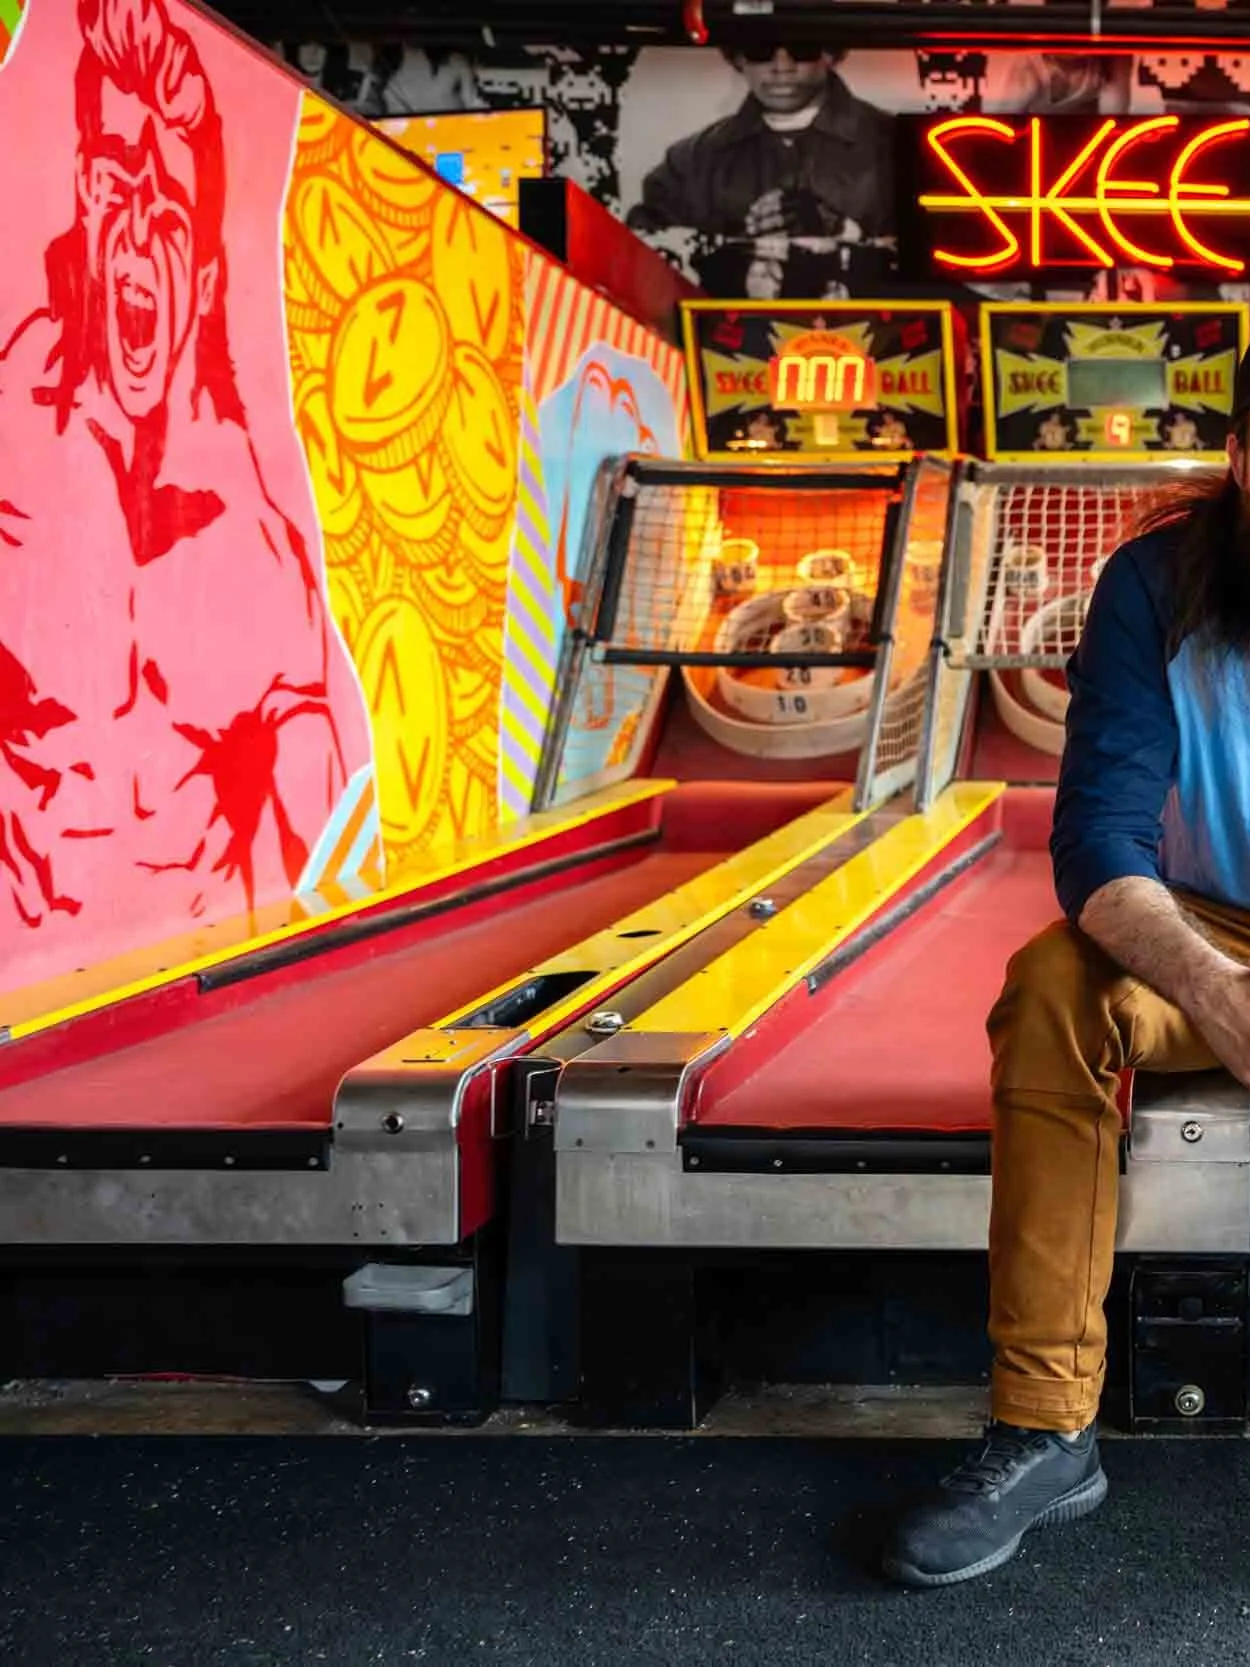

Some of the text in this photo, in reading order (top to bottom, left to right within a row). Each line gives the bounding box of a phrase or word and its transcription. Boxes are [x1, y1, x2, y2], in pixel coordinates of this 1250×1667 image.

[880, 370, 932, 395] BALL
[1173, 370, 1227, 395] BALL
[777, 694, 808, 715] 10
